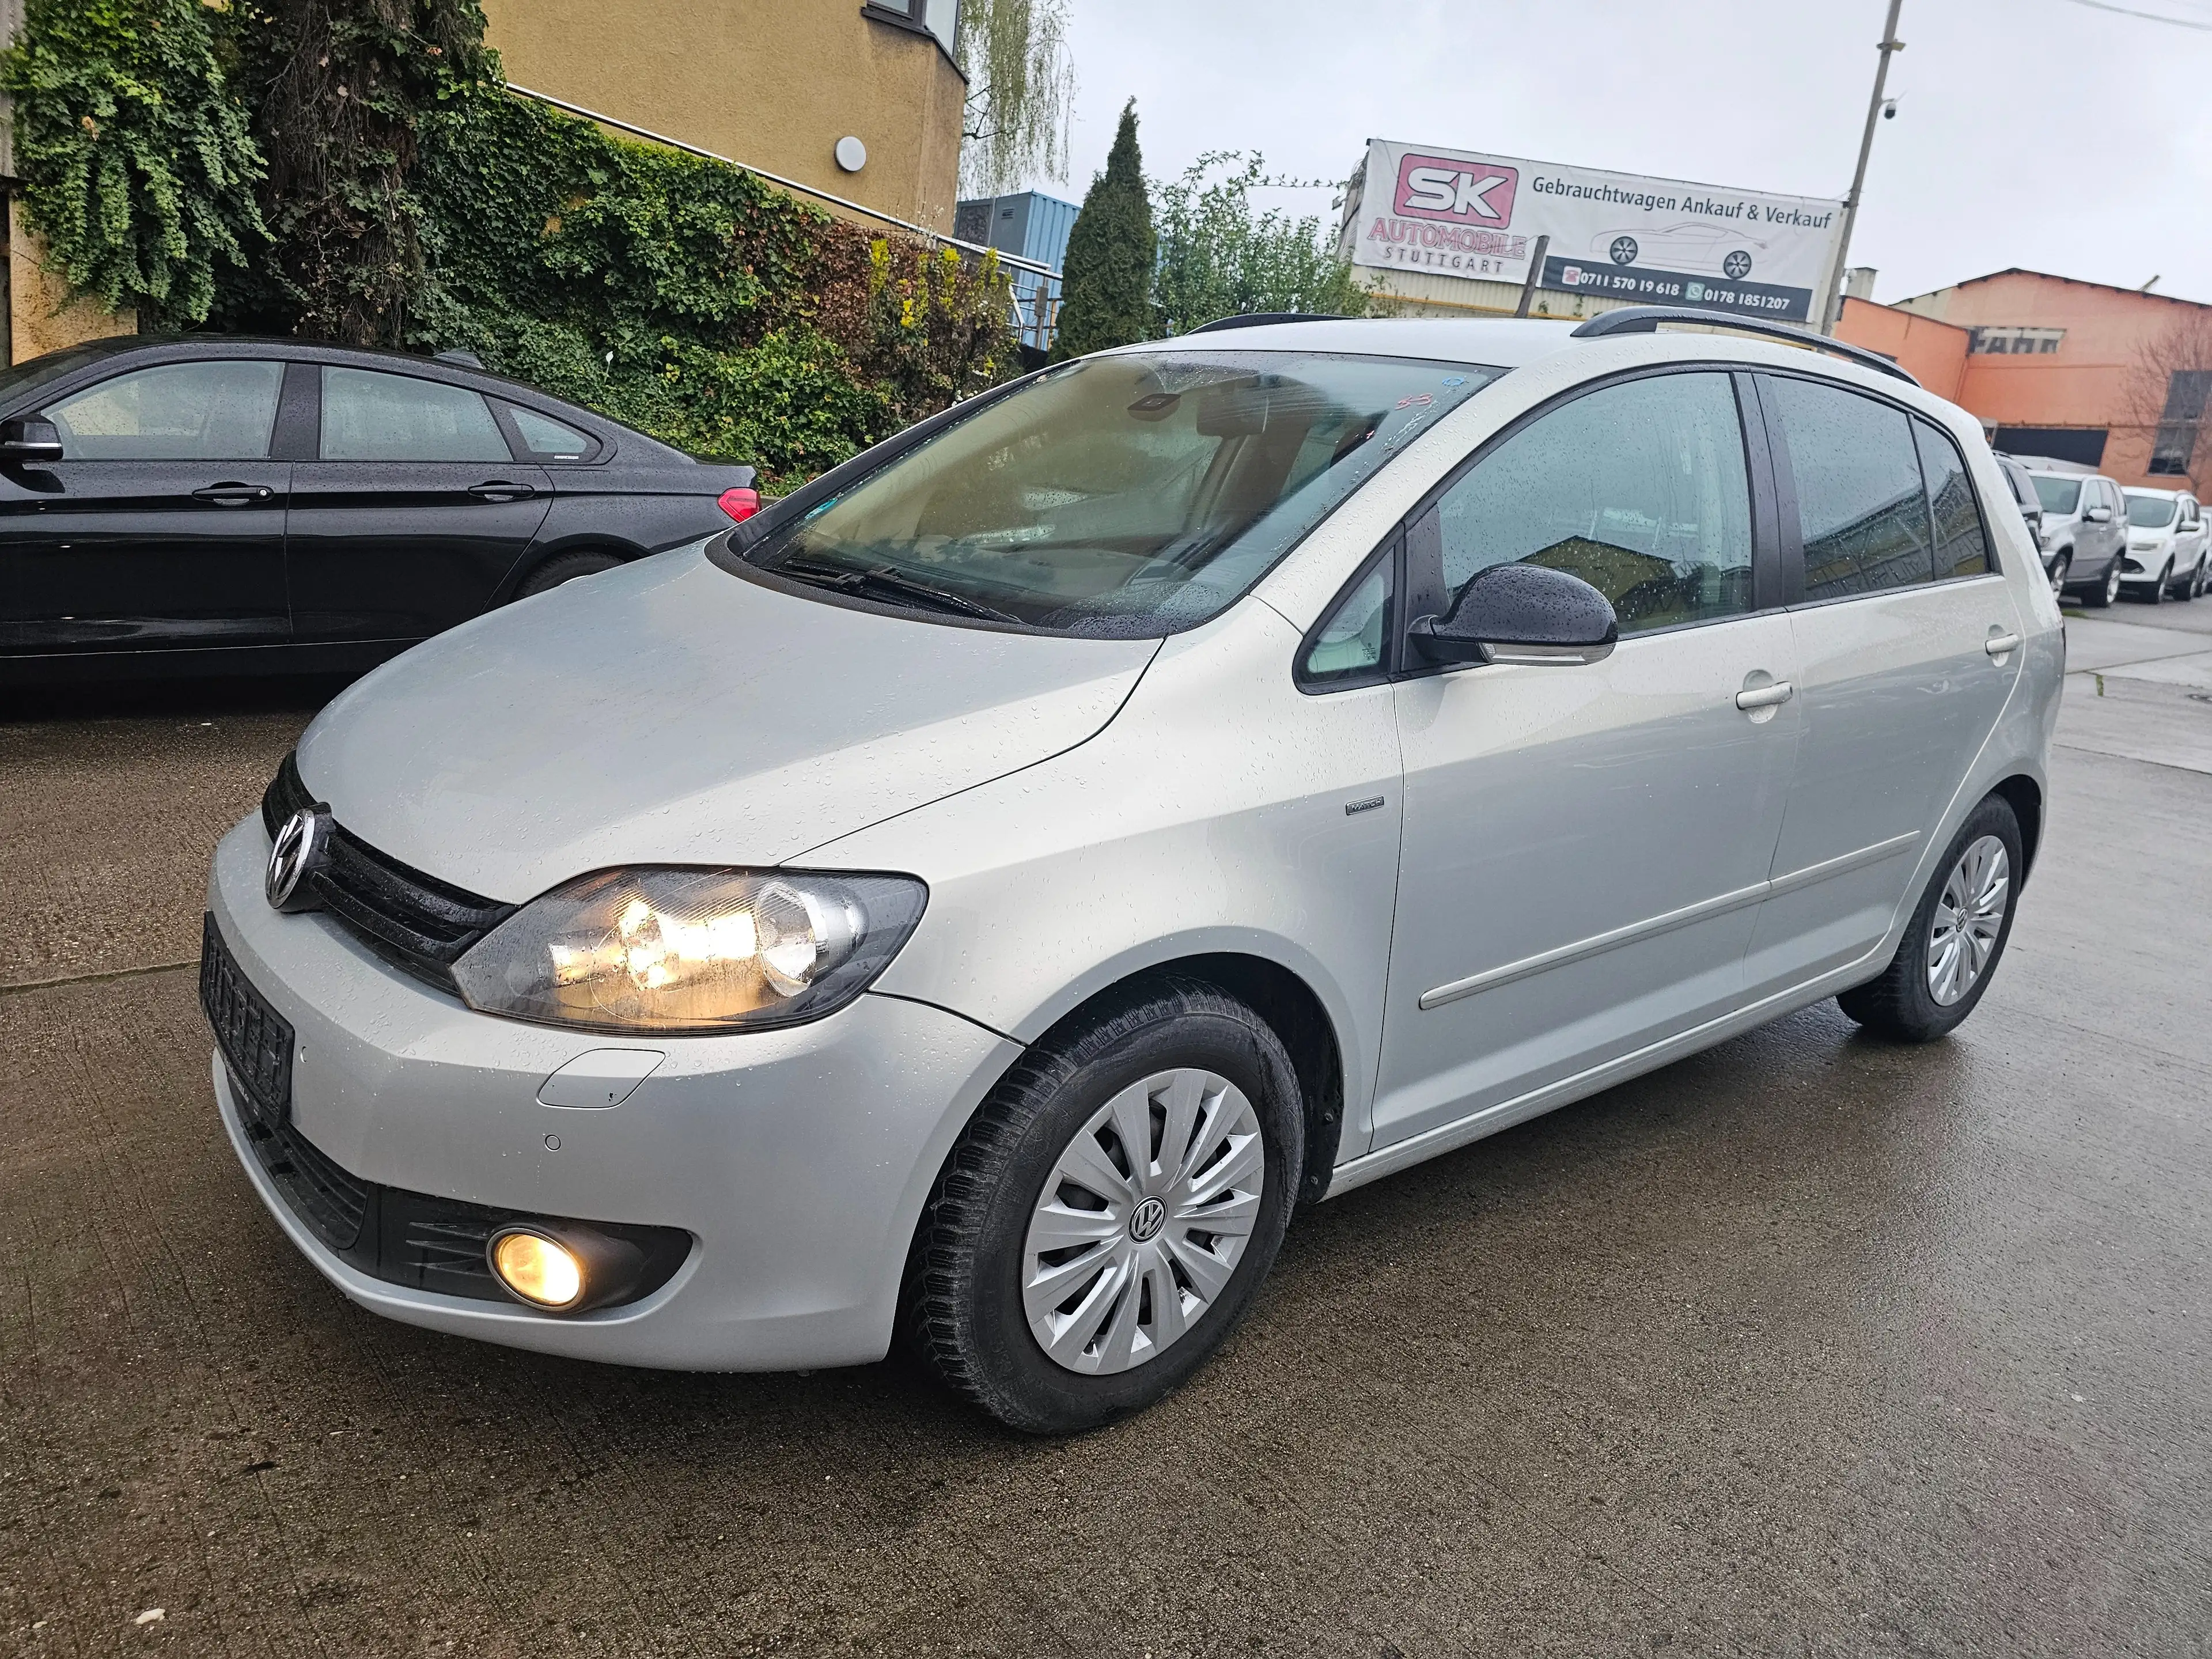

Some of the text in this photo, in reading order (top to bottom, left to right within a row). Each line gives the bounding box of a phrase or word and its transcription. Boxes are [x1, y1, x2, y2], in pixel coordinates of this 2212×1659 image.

[1403, 166, 1509, 220] SK
[1532, 176, 1832, 229] Gebrauchtwagen Ankauf & Verkauf
[1367, 217, 1527, 260] AUTOMOBILE
[1384, 246, 1504, 274] STUTTGART
[1580, 271, 1609, 287] 0711
[1612, 276, 1637, 290] 570
[1704, 289, 1735, 304] 0178
[1738, 293, 1790, 310] 1851207
